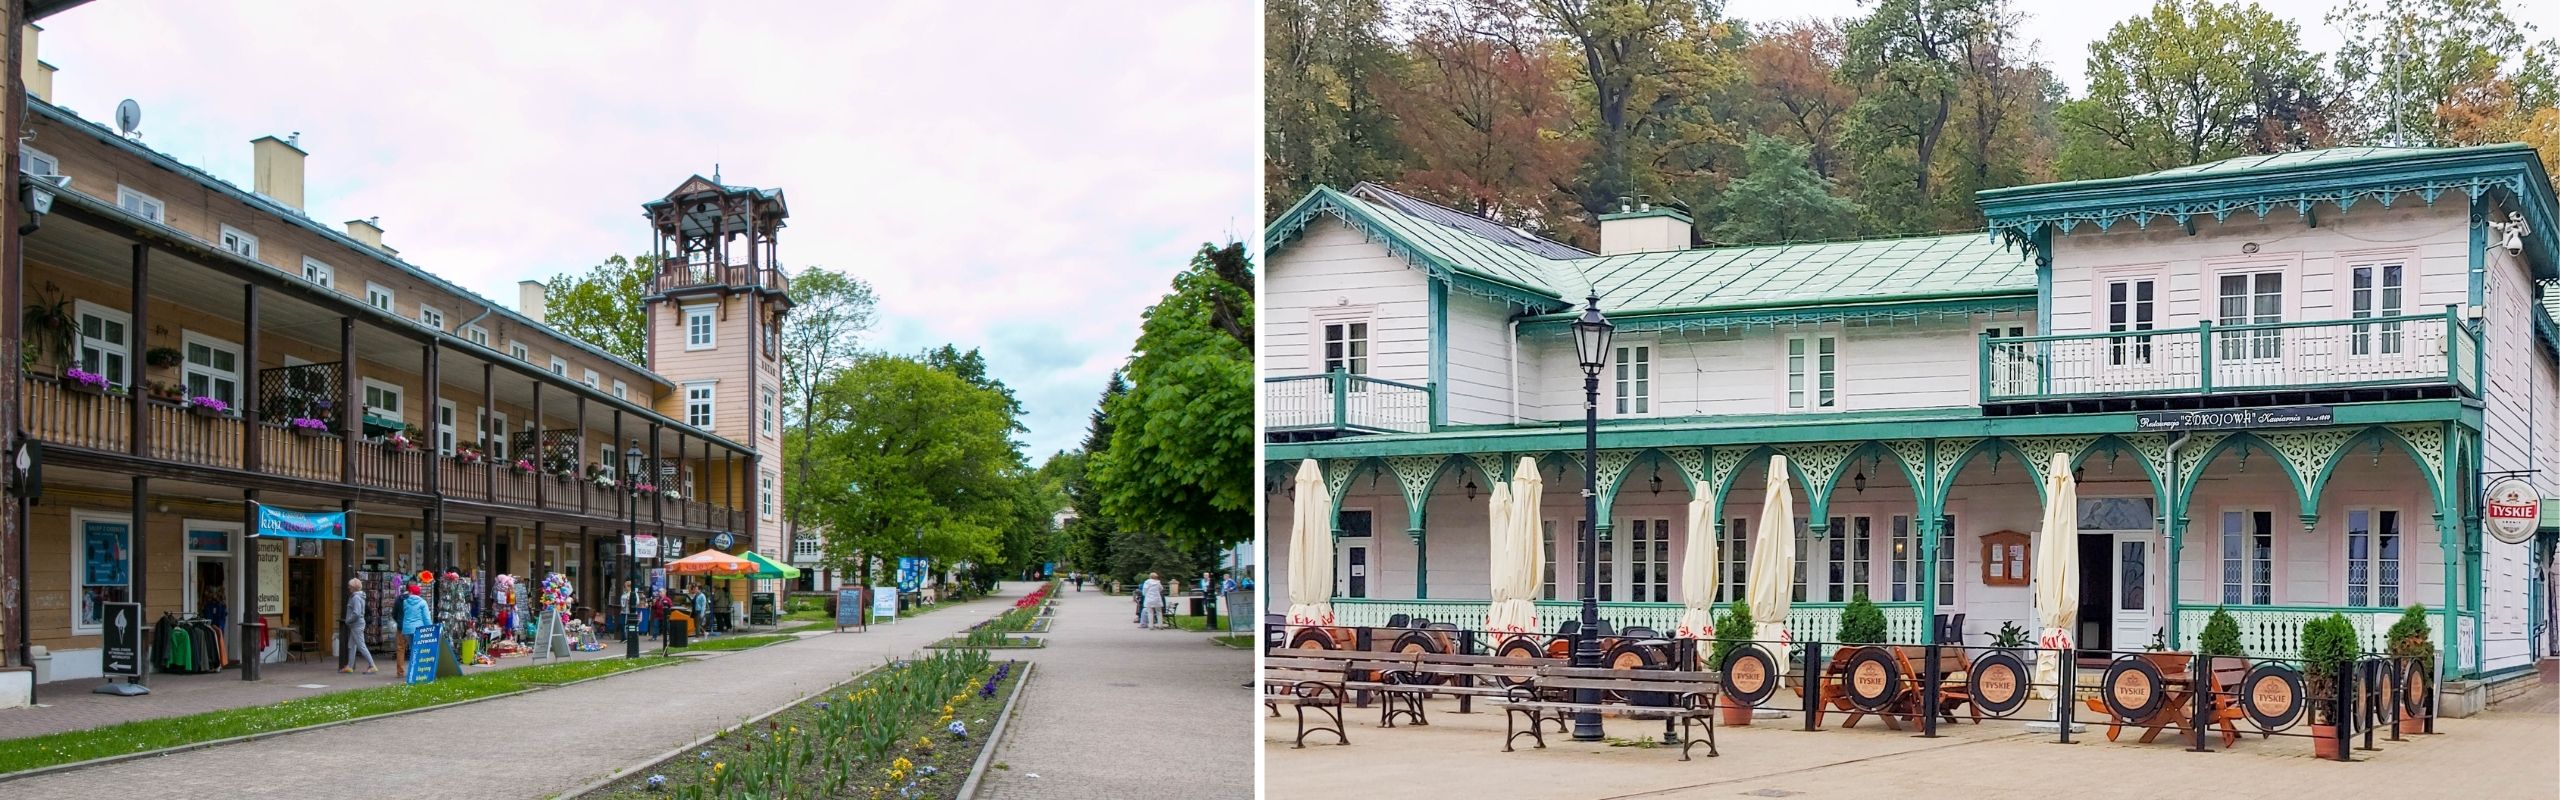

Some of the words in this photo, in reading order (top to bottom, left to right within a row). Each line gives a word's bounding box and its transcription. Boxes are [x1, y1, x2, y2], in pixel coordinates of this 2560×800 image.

[2258, 412, 2300, 424] Kawiarnia
[2491, 505, 2533, 517] TYSKIE
[256, 543, 282, 553] smetyki
[258, 604, 276, 612] erfum
[1859, 677, 1882, 685] TYSKIE
[1984, 682, 2011, 690] TYSKIE
[2120, 687, 2145, 695] TYSKIE
[2258, 694, 2286, 703] TYSKIE
